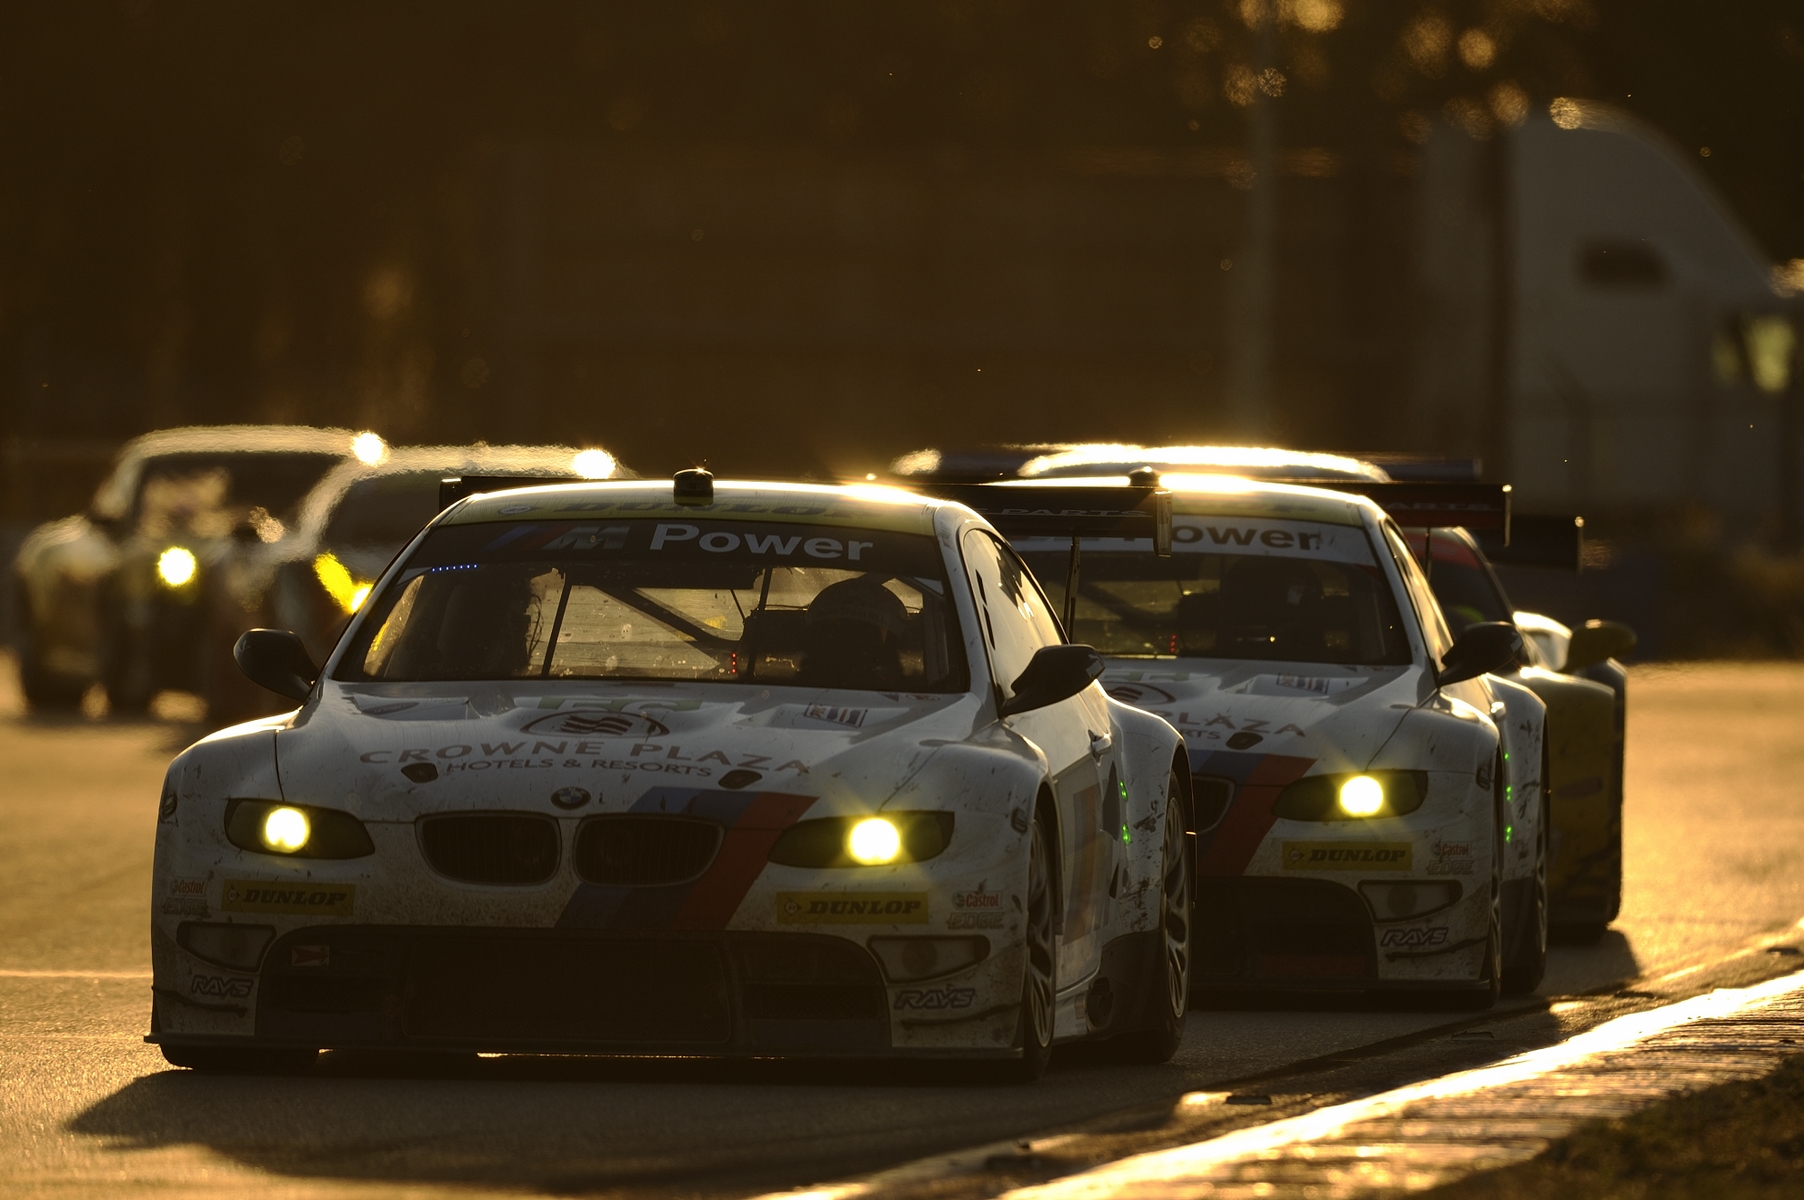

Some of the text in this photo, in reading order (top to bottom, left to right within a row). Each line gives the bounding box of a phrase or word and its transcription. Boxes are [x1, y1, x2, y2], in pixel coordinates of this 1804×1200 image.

[1000, 508, 1148, 517] PARTS
[1378, 502, 1491, 511] ARTS
[650, 523, 873, 561] Power
[1172, 525, 1322, 551] ower
[360, 741, 810, 775] CROWNE PLAZA
[446, 759, 712, 778] HOTELS & RESORTS
[1309, 849, 1406, 863] DUNLOP
[1442, 843, 1470, 856] Castrol
[1426, 860, 1475, 876] EDGE
[178, 879, 205, 894] Castrol
[242, 888, 347, 906] DUNLOP
[966, 893, 999, 908] Castrol
[807, 900, 921, 915] DUNLOP
[946, 912, 1006, 930] EDGE
[1381, 927, 1449, 947] RAYS
[191, 975, 254, 997] RAYS
[894, 988, 976, 1010] RAYS
